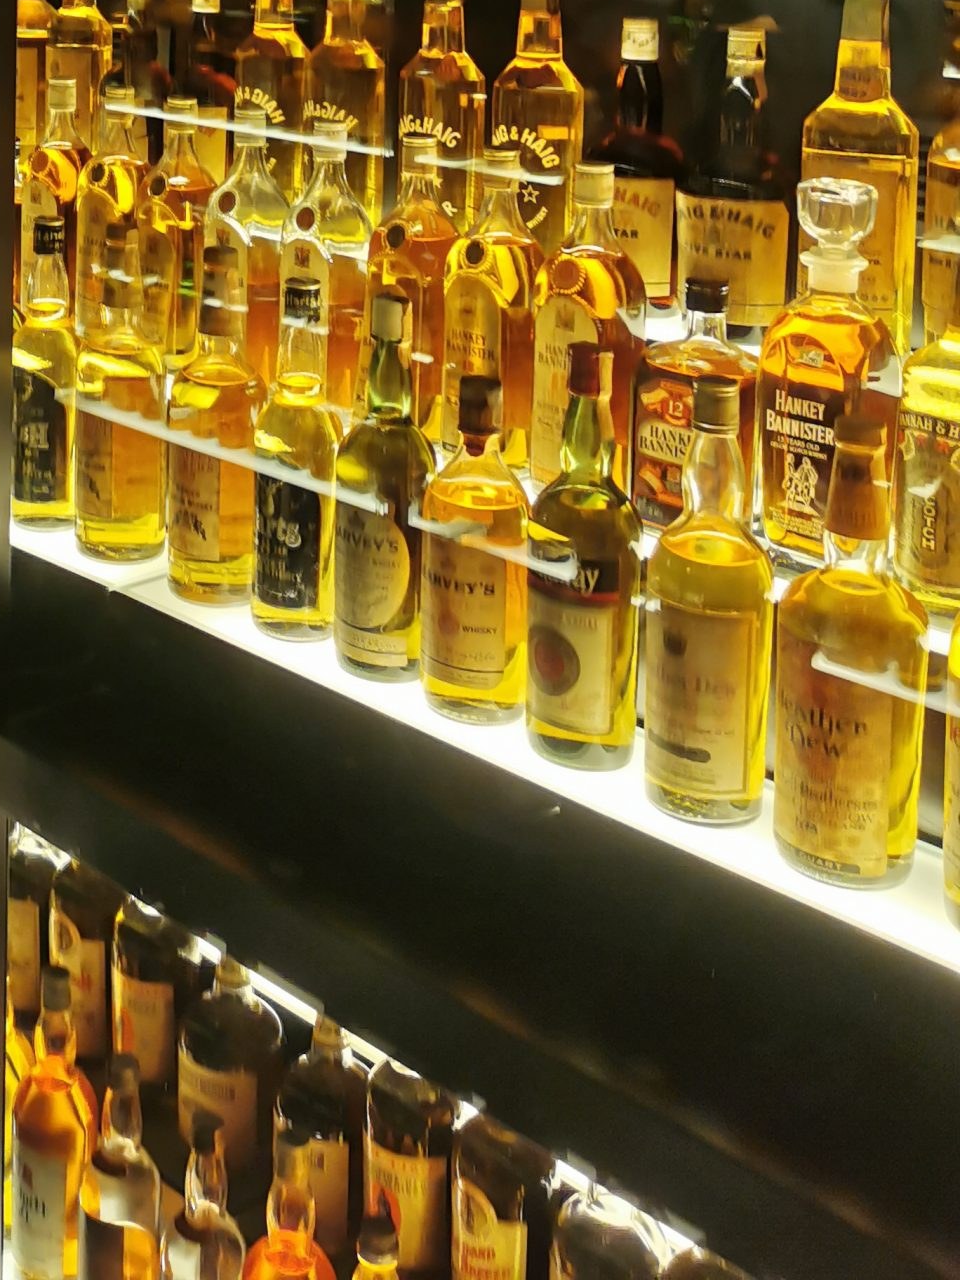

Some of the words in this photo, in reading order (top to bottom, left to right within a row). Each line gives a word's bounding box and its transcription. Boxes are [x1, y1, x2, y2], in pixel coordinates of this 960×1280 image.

[422, 116, 462, 149] HAIG
[509, 125, 519, 140] &
[520, 128, 561, 169] HAIG
[614, 227, 639, 239] TAR
[727, 207, 777, 239] HAIG
[537, 351, 568, 370] BANNI
[668, 400, 684, 417] 12
[775, 389, 826, 421] HANKEY
[766, 408, 836, 446] BANNISTER
[935, 420, 946, 434] &
[948, 424, 960, 439] H
[639, 434, 687, 458] BANNIS
[806, 441, 821, 452] OLD
[921, 496, 936, 553] COTCH
[461, 625, 498, 636] WHISKY
